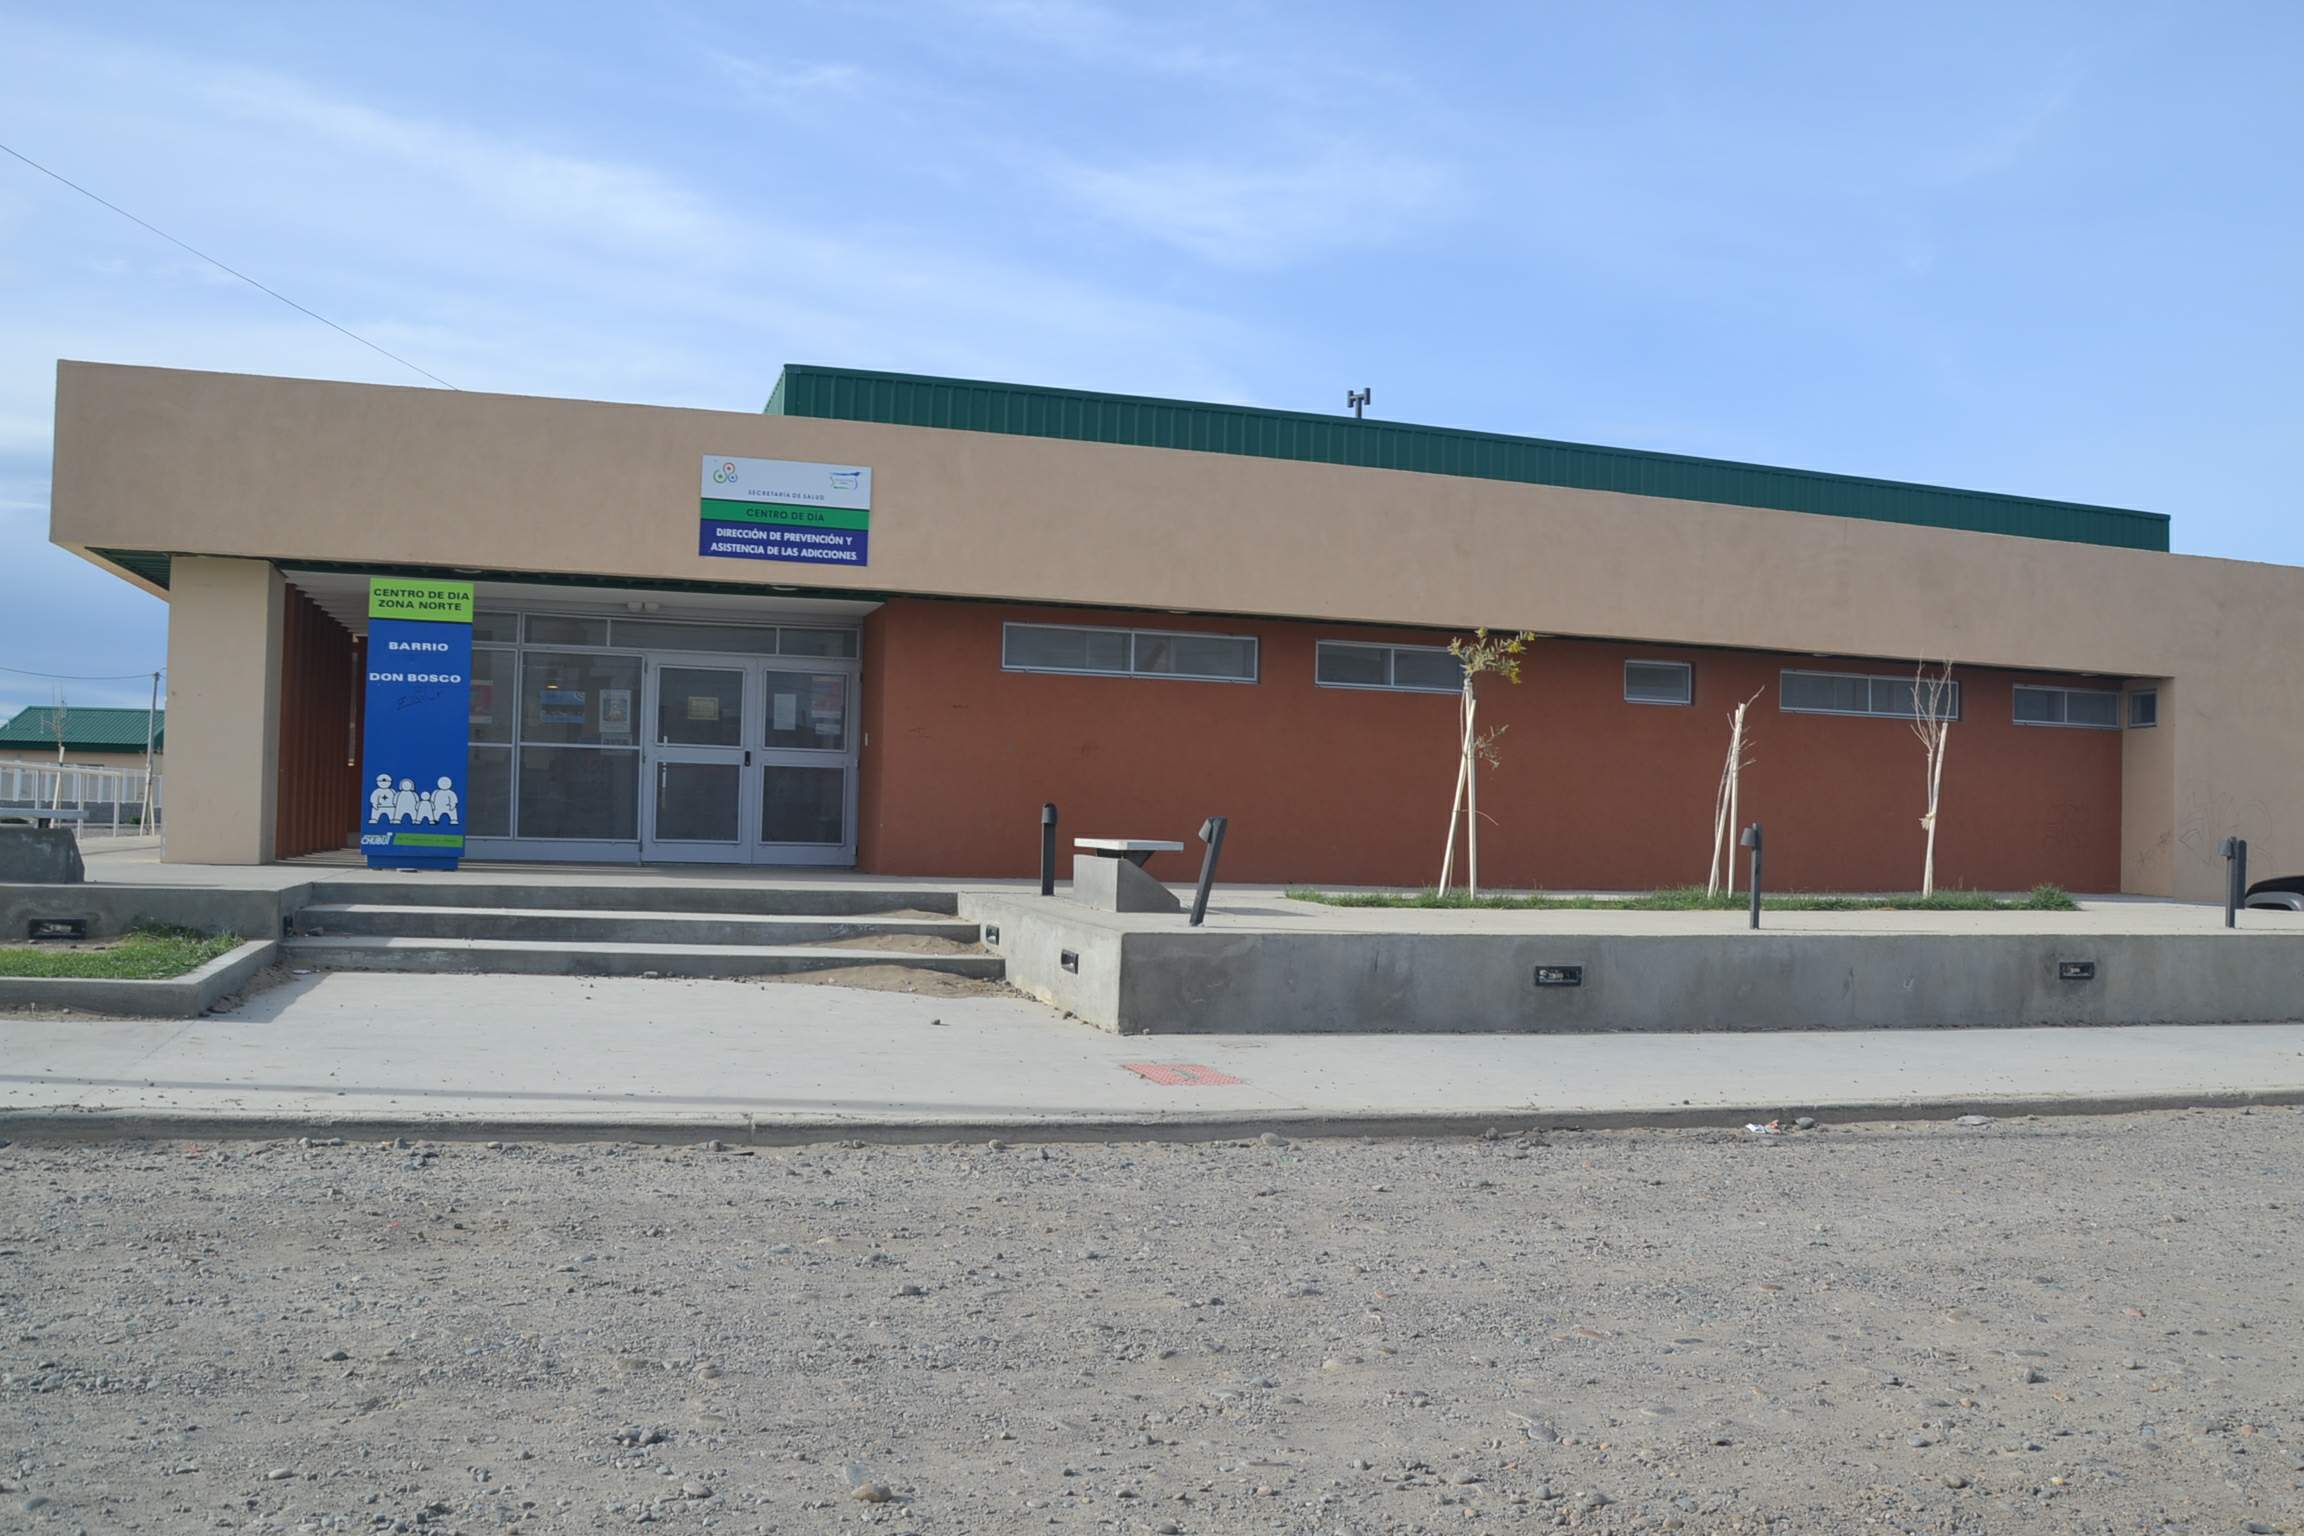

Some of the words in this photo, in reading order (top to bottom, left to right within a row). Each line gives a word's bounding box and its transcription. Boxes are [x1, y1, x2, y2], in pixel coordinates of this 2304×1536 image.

[746, 508, 788, 519] CENTRO
[791, 511, 805, 521] DE
[717, 528, 767, 540] DIRECCIÓN
[769, 531, 782, 541] DE
[783, 532, 844, 545] PREVENCIÓN
[846, 536, 853, 546] Y
[710, 543, 765, 554] ASISTENCIA
[767, 546, 779, 555] DE
[781, 547, 799, 557] LAS
[800, 548, 857, 561] ADICCIONES
[374, 589, 425, 598] CENTRO
[428, 592, 444, 600] DE
[447, 592, 470, 601] DIA
[378, 599, 414, 609] ZONA
[418, 601, 462, 611] NORTE
[389, 642, 449, 651] BARRIO
[369, 672, 404, 682] DON
[408, 674, 461, 683] BOSCO
